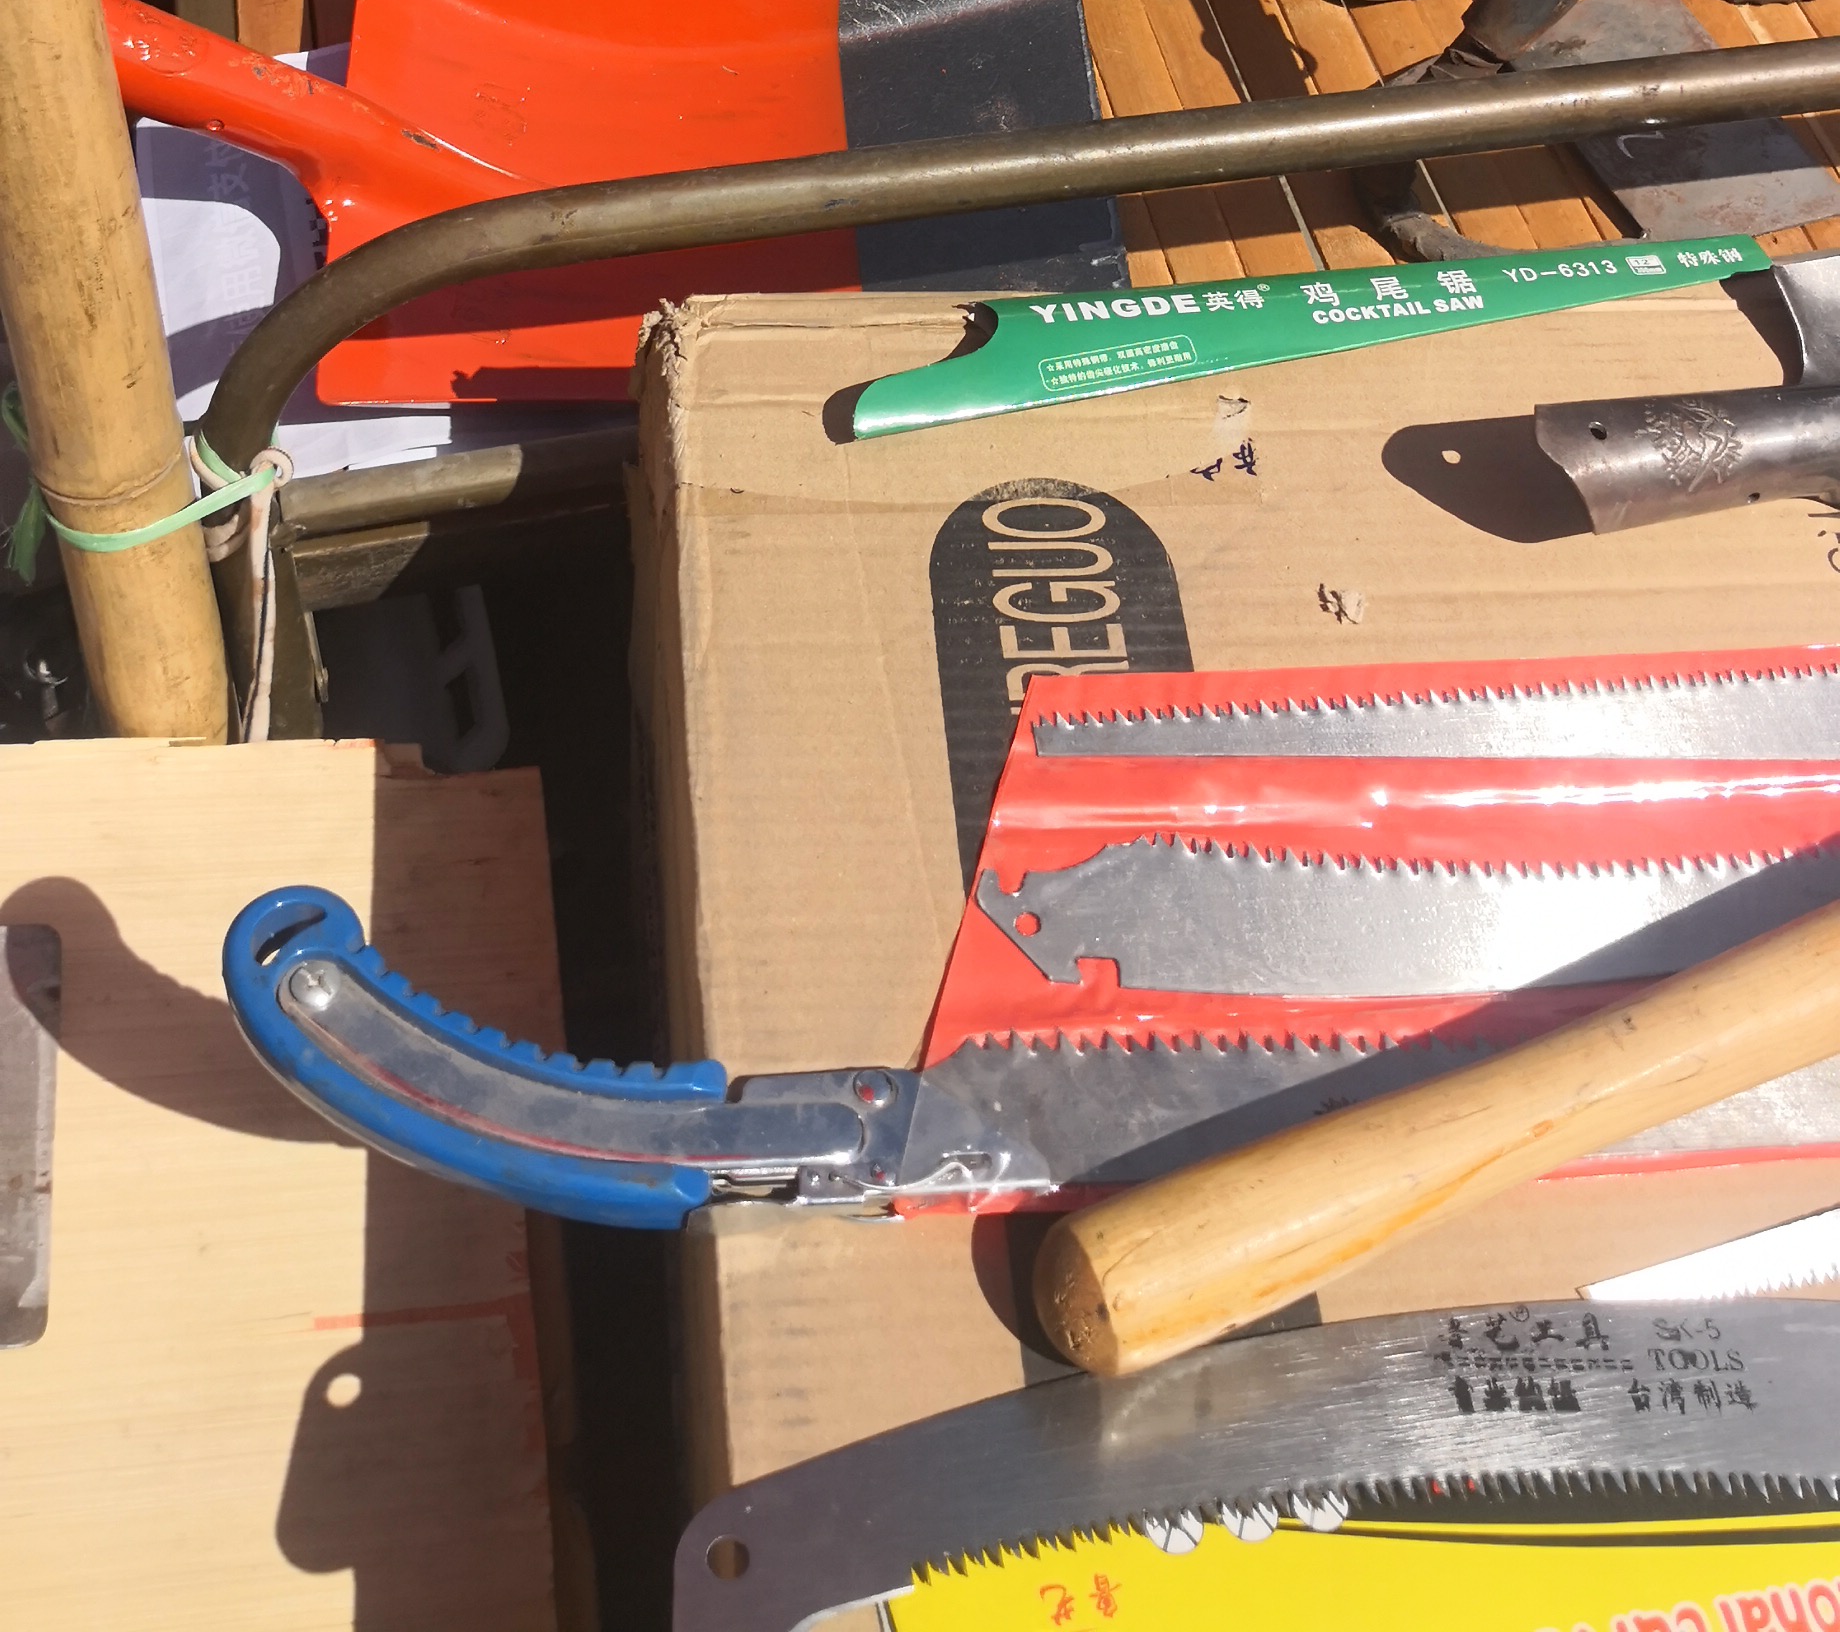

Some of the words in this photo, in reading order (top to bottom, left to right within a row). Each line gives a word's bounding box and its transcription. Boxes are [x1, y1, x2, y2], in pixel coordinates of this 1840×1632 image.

[1676, 247, 1744, 269] 特殊钢
[1029, 293, 1202, 324] YINGDE
[1202, 288, 1265, 312] 英得
[1312, 300, 1432, 325] COCKTAIL
[1433, 294, 1485, 313] SAW
[981, 497, 1129, 715] REGUO
[1647, 1347, 1745, 1372] TOOLS
